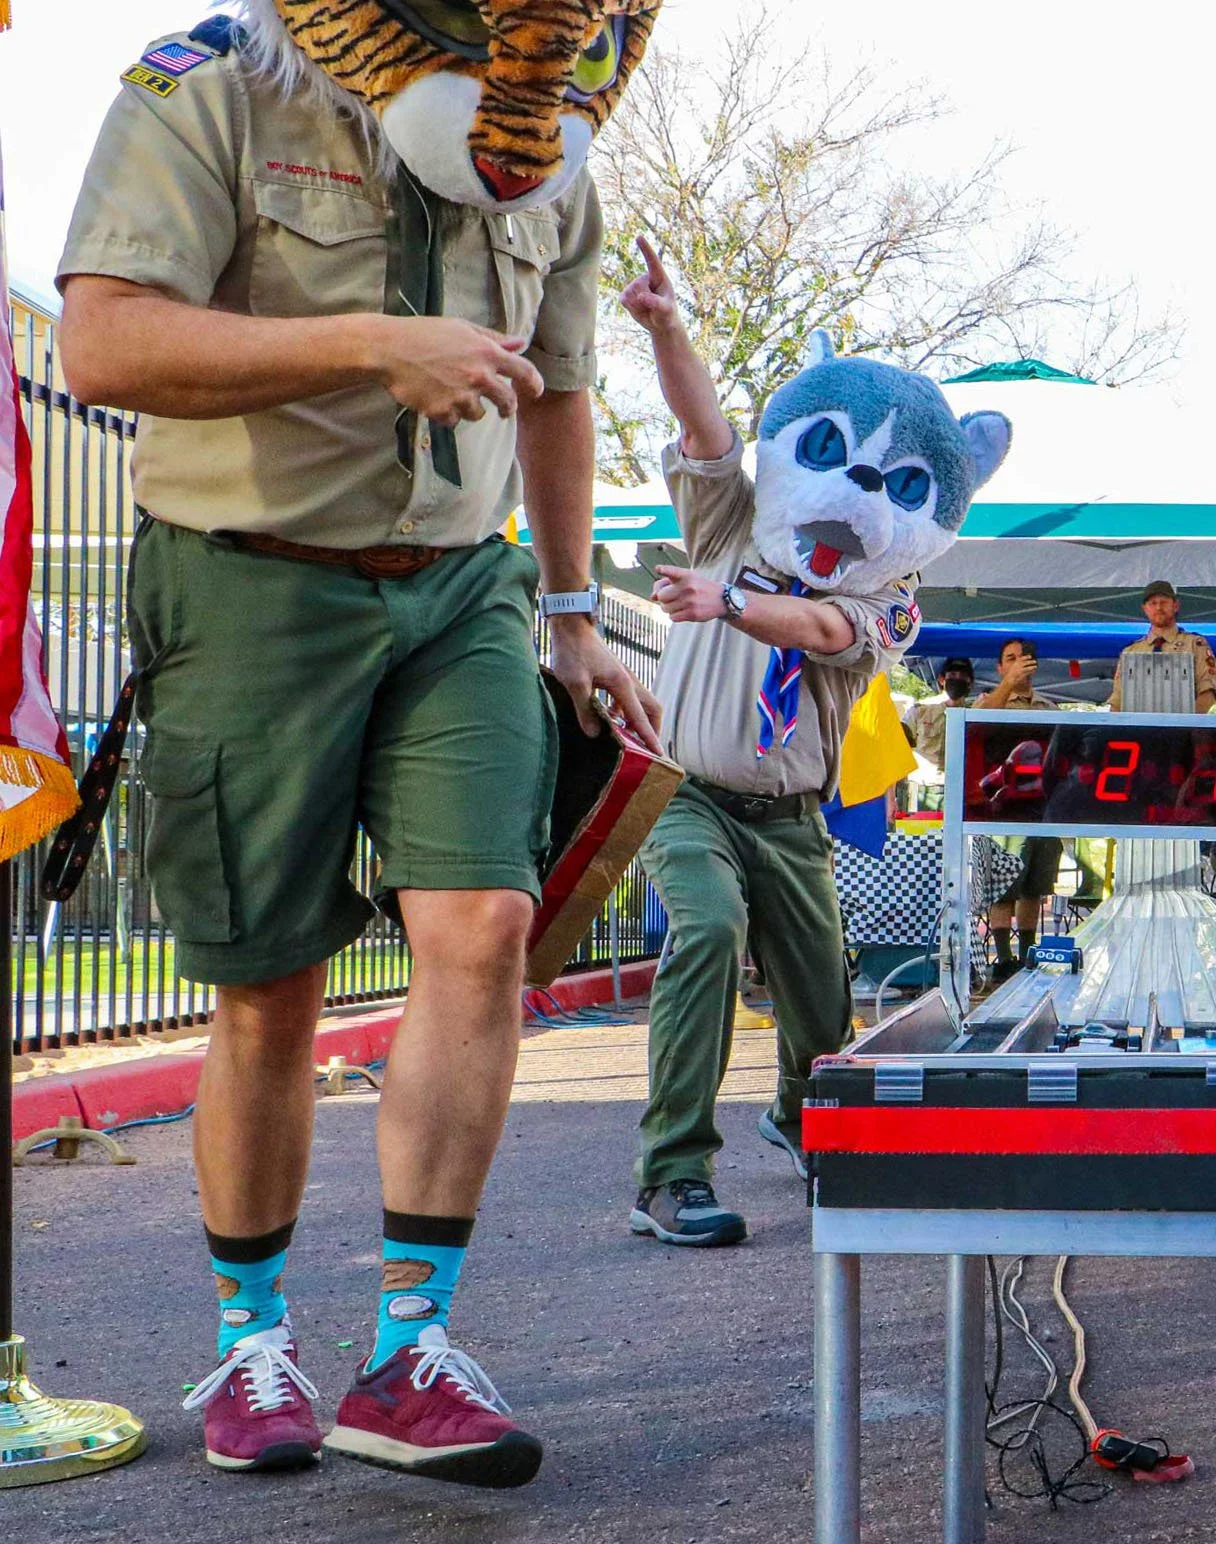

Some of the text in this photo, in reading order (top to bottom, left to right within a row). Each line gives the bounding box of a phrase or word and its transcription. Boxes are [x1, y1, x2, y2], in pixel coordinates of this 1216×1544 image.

[150, 78, 163, 89] 2
[266, 161, 282, 170] BOY
[284, 163, 317, 177] SCOUTS
[329, 171, 362, 184] AMERICA
[1095, 741, 1141, 800] 2
